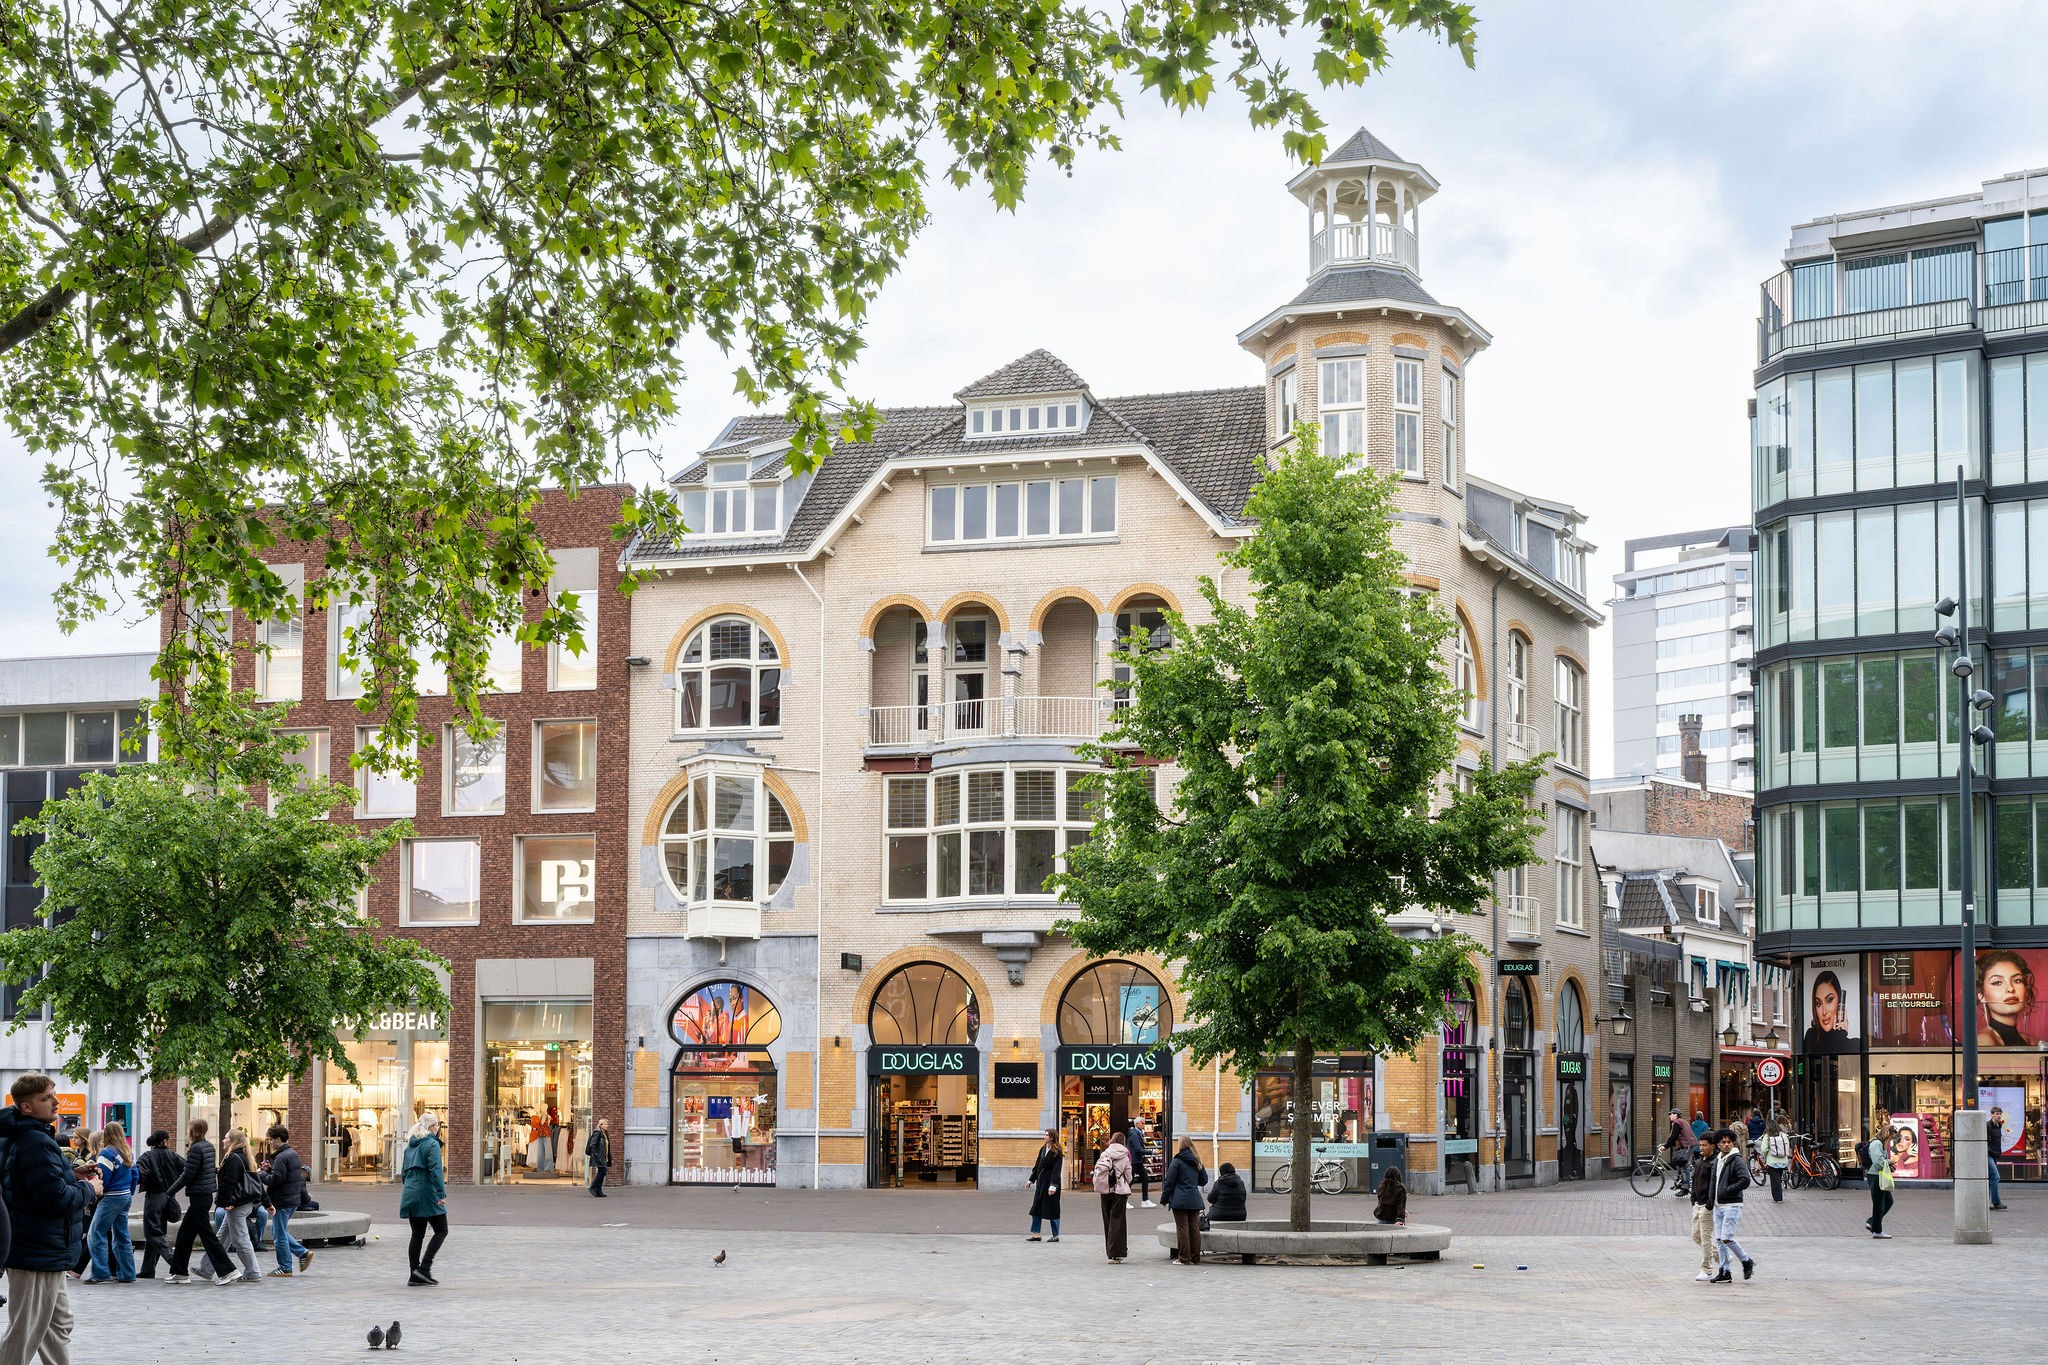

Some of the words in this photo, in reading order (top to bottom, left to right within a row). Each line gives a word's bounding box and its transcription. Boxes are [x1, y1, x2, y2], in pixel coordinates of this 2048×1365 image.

[1891, 992, 1935, 1000] BEAUTIFUL
[1899, 1000, 1941, 1008] YOURSELF
[881, 1053, 964, 1070] DOUGLAS
[1071, 1053, 1157, 1071] DOUGLAS
[1561, 1061, 1582, 1074] DOUGLAS
[1655, 1065, 1671, 1077] DOUGLAS
[1001, 1076, 1031, 1084] DOUGLAS
[1286, 1101, 1340, 1111] FEVER
[1287, 1113, 1340, 1123] SMER
[1263, 1145, 1282, 1153] 25%
